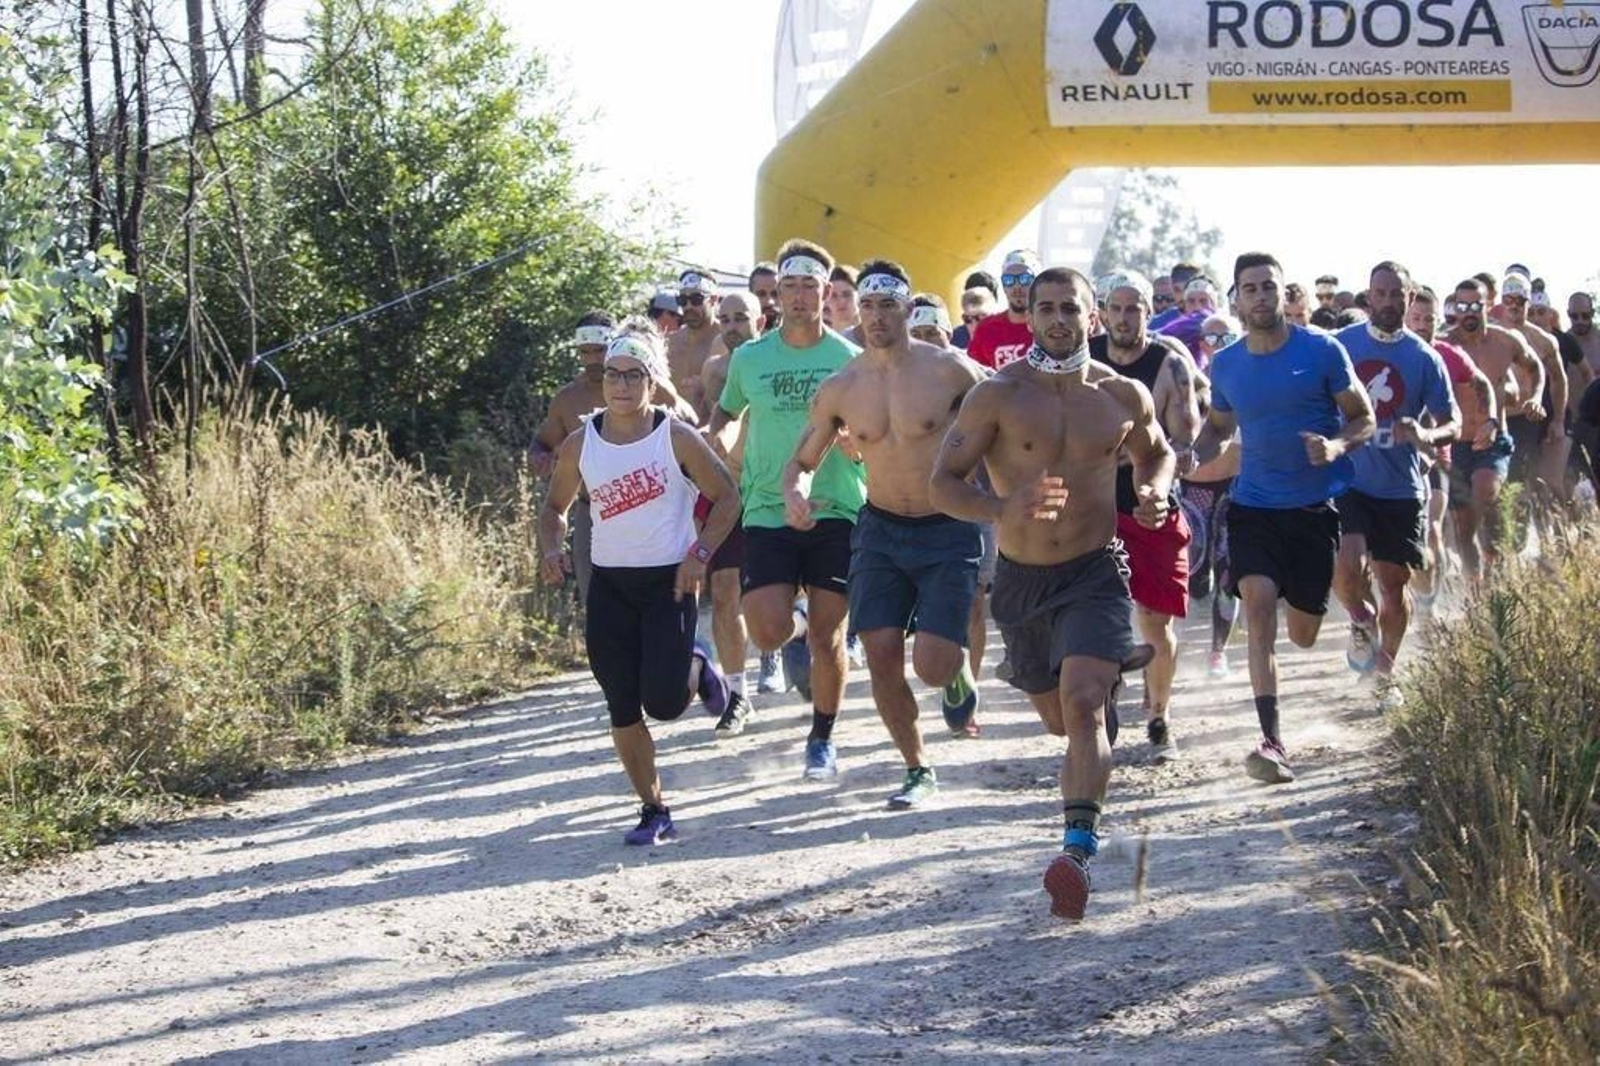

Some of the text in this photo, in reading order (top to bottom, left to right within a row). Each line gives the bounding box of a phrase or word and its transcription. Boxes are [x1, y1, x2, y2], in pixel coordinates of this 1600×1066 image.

[1207, 0, 1504, 48] RODOSA
[1538, 17, 1599, 29] DACIA
[1207, 58, 1510, 76] VIGO NIGRÁN CANGAS PONTEAREAS
[1061, 83, 1194, 102] RENAULT
[1252, 88, 1467, 106] www.rodosa.com
